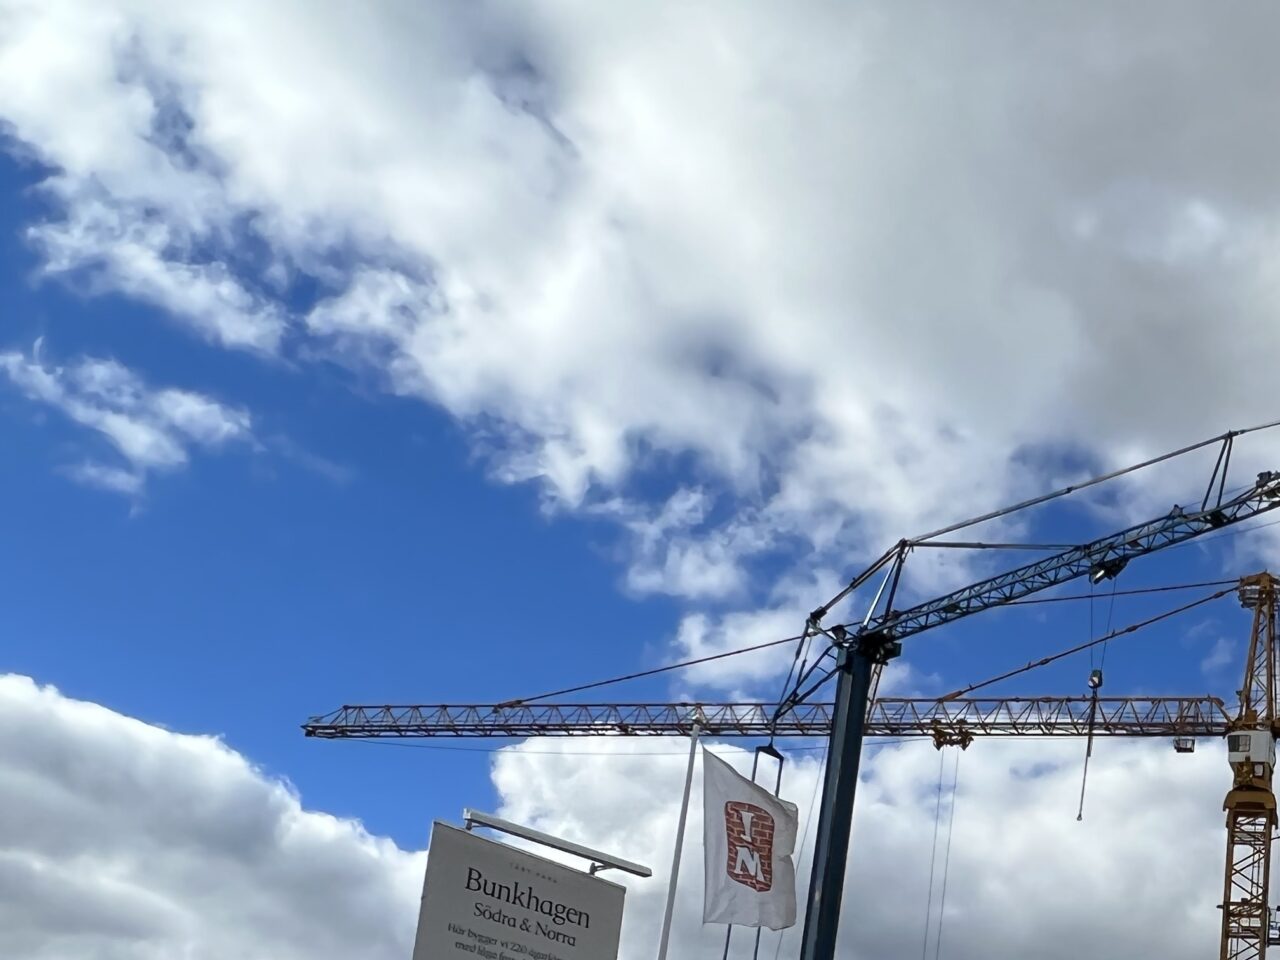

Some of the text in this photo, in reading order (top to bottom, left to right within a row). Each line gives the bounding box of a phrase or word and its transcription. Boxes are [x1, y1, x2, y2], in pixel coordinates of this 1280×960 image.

[464, 867, 590, 929] Bunkhagen
[473, 902, 577, 947] Södra & Norra
